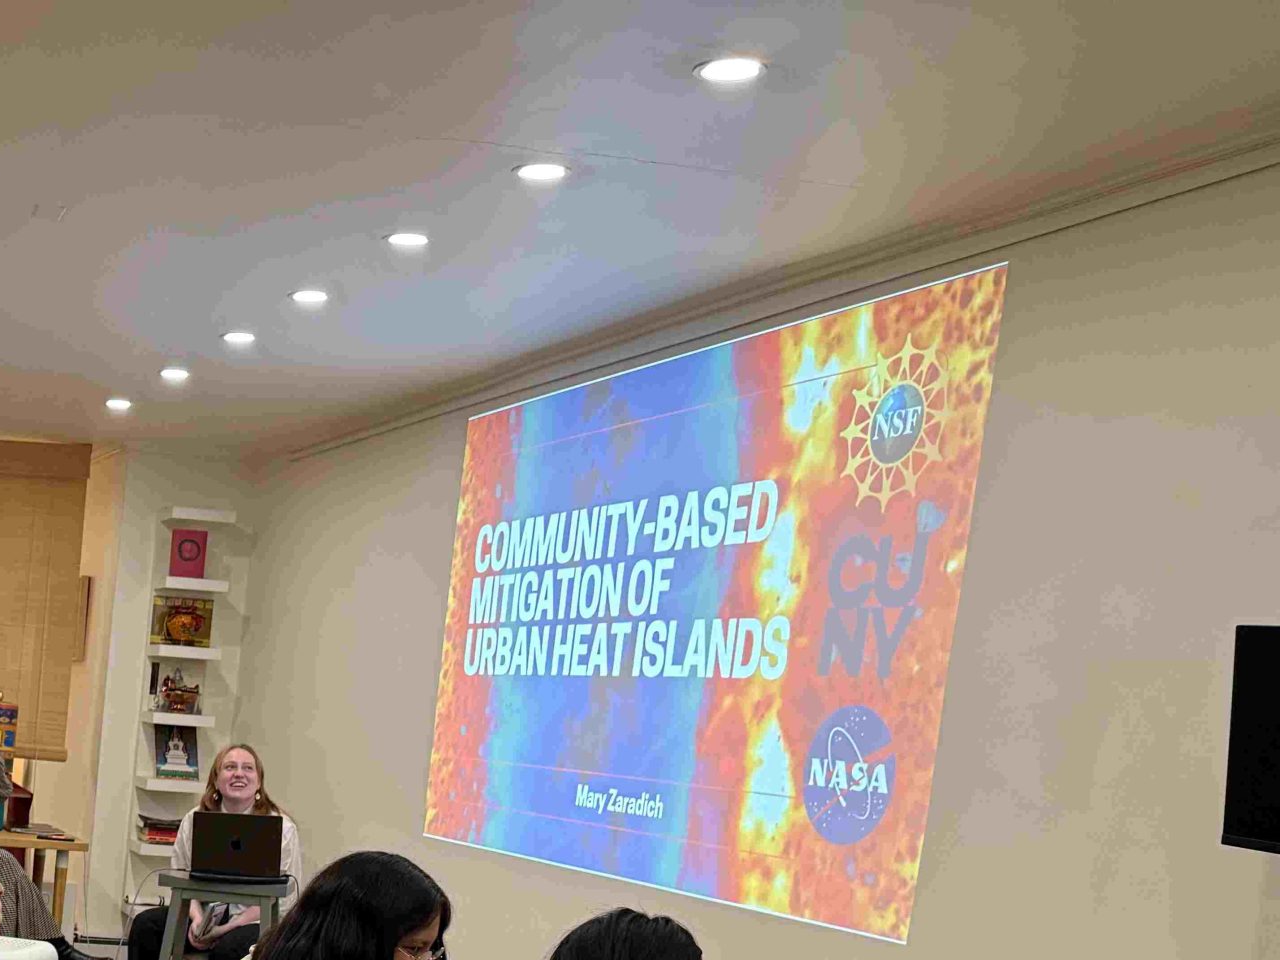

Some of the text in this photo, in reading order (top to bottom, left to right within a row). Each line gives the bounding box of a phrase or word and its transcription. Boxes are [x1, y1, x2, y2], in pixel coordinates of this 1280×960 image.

[872, 406, 922, 440] NSF
[475, 479, 778, 574] COMMUNITY-BASED
[468, 557, 675, 625] MITIGATION OF
[464, 615, 791, 681] URBAN HEAT ISLANDS
[575, 783, 664, 819] Mary Zaradich
[808, 757, 888, 794] NASA
